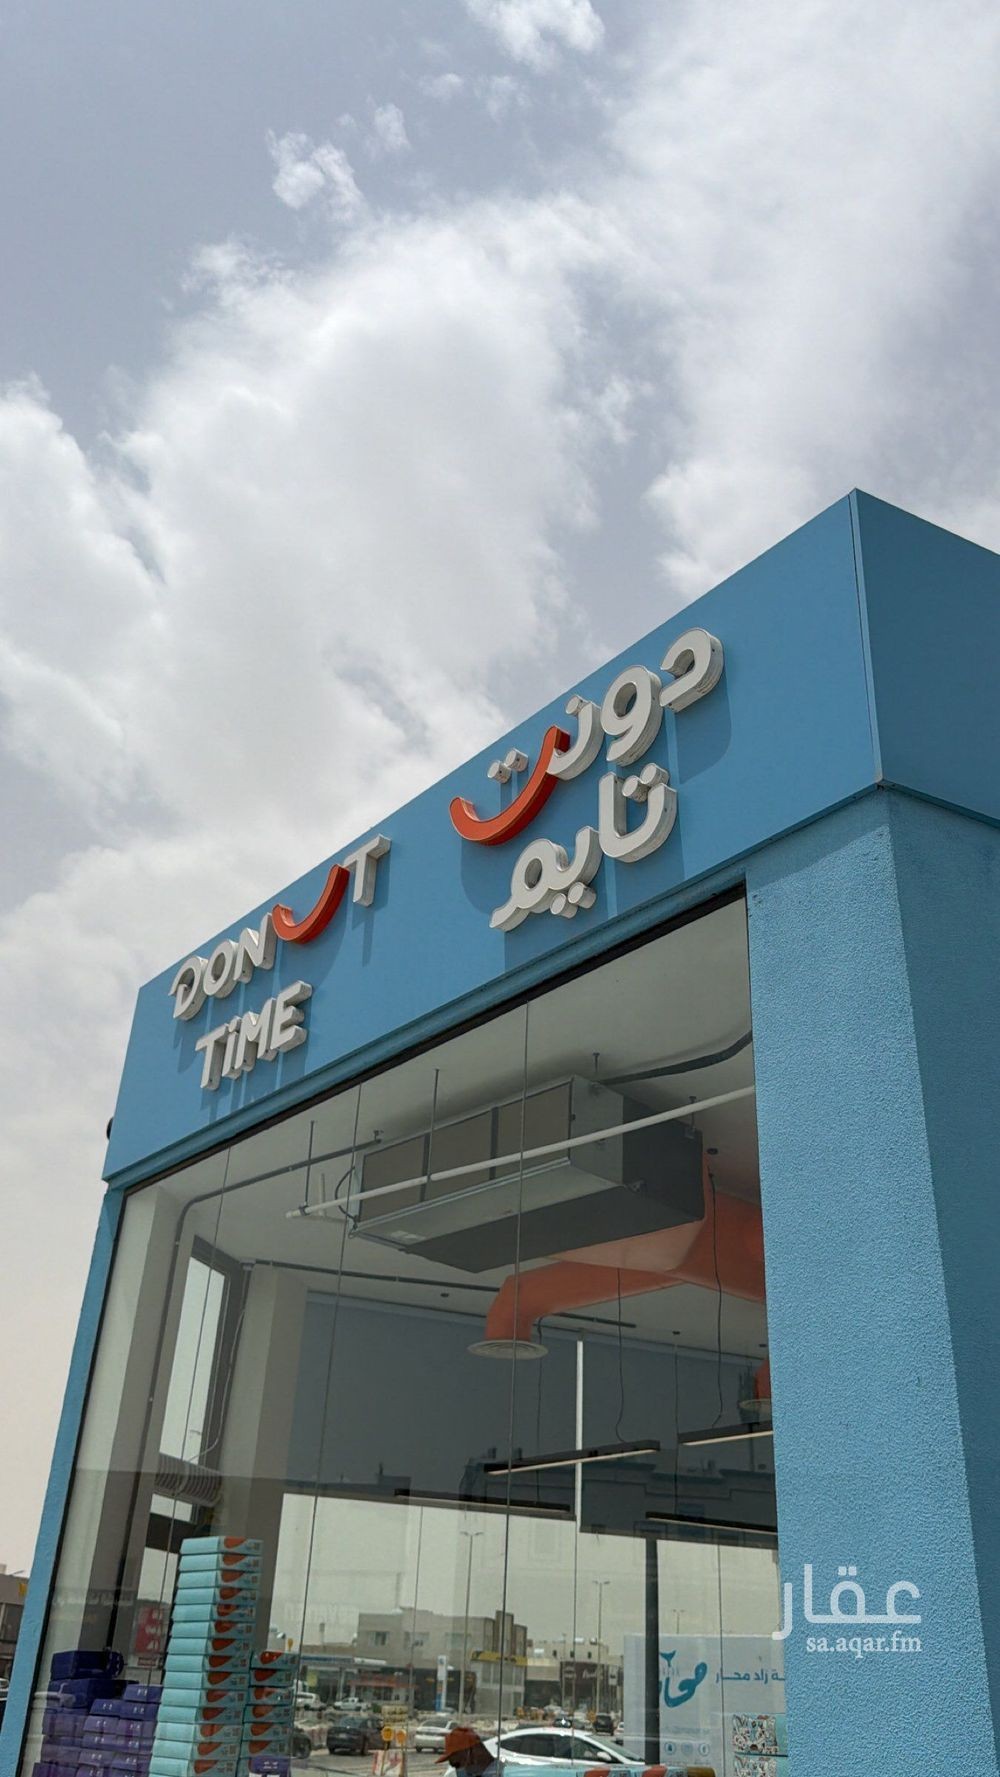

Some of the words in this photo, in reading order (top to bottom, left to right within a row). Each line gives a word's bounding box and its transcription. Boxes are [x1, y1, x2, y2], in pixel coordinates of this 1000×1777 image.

[449, 627, 724, 846] دونت
[168, 833, 391, 1021] DONUT
[488, 762, 678, 932] تايم
